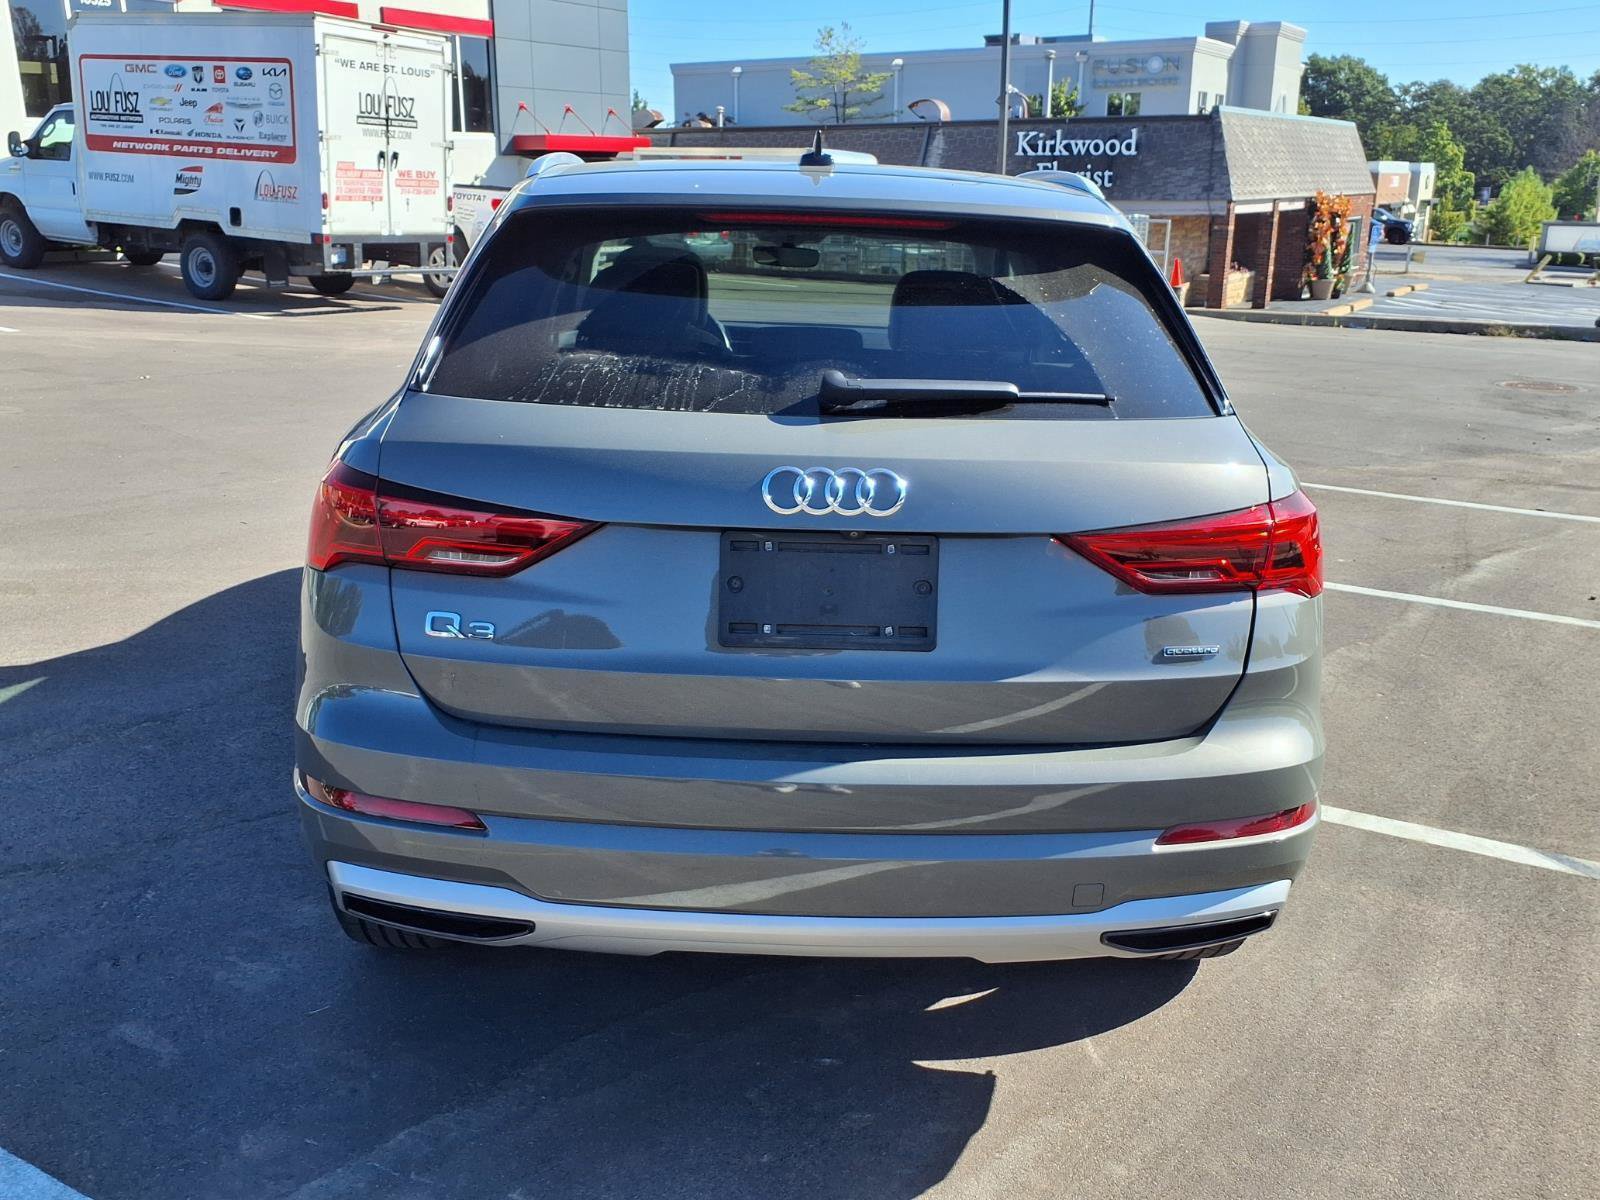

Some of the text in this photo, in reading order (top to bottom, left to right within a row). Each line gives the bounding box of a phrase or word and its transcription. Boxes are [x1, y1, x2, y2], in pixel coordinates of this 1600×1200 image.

[124, 63, 158, 74] GMC
[262, 67, 288, 77] KIA
[359, 61, 380, 73] ARE
[383, 64, 398, 74] ST.
[89, 89, 141, 113] LOU FUSZ
[179, 97, 198, 108] Jeep
[358, 92, 416, 119] LOU FUSZ
[158, 116, 192, 125] POLARIS
[265, 114, 290, 125] BUICK
[194, 131, 223, 140] HONDA
[361, 127, 413, 140] WWW.FSZ.COM
[1014, 127, 1139, 157] Kirkwood
[112, 140, 279, 159] NETWORK PARTS DELIVERY
[88, 170, 135, 184] WWW.FUSZ.COM
[175, 172, 202, 188] Mighty
[397, 169, 437, 179] WE BUY
[259, 183, 276, 197] LOU
[277, 184, 298, 200] FUSZ
[424, 610, 496, 641] Q3
[1167, 647, 1219, 656] quattro
